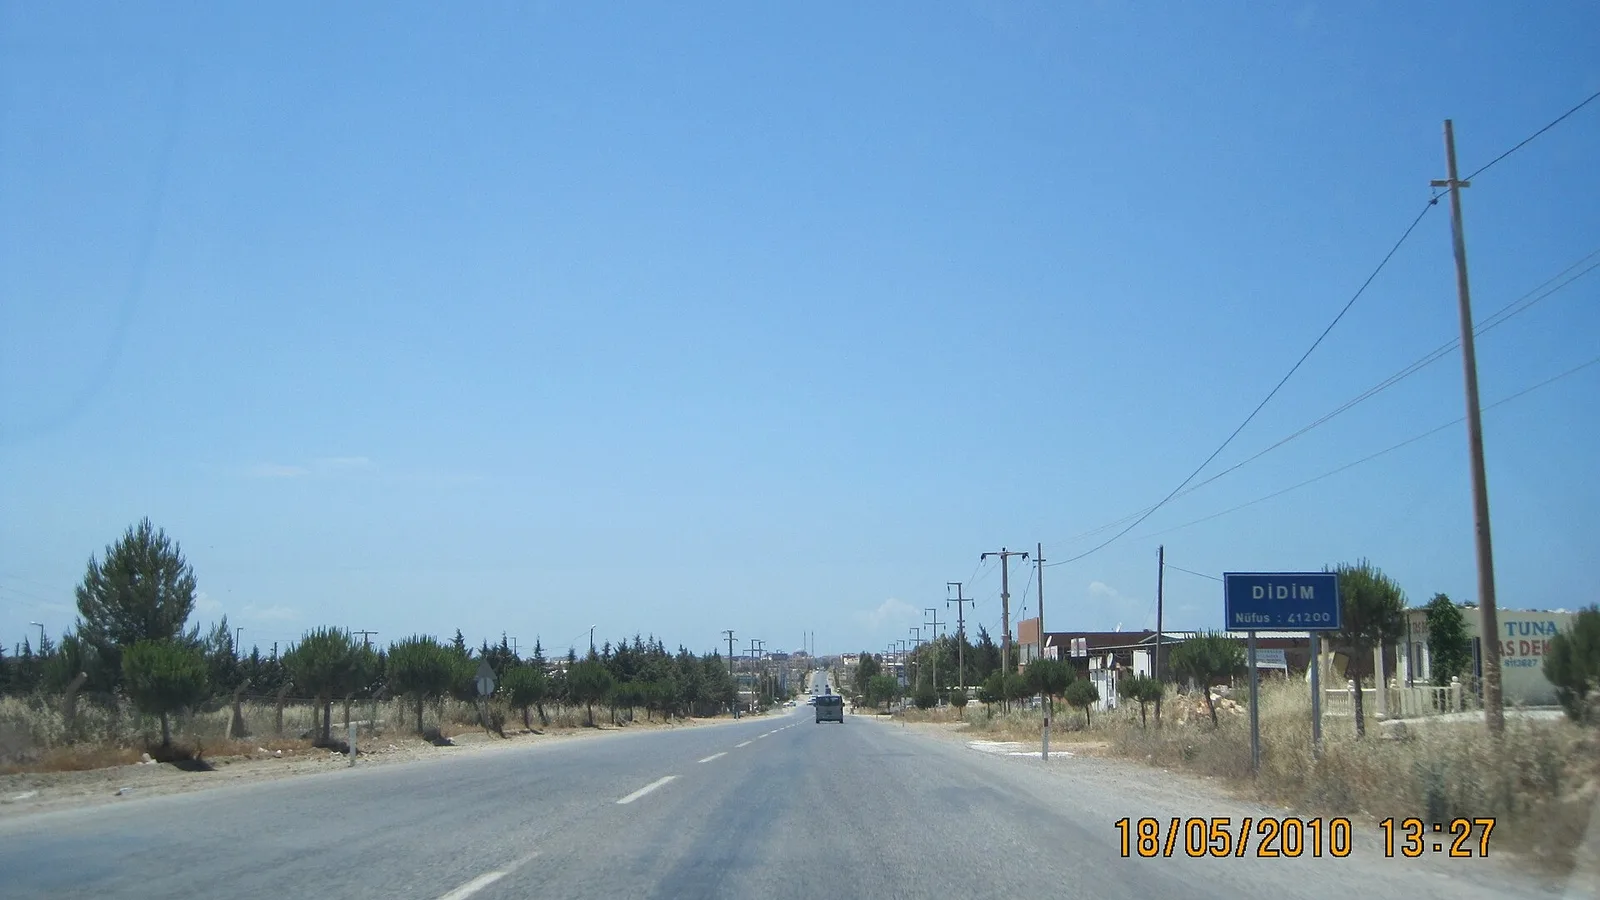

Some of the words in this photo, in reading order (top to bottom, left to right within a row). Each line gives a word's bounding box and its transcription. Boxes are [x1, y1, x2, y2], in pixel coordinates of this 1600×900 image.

[1252, 583, 1315, 600] DİDİM
[1235, 612, 1270, 623] Nüfus
[1287, 612, 1331, 623] 41200
[1504, 621, 1557, 636] TUNA
